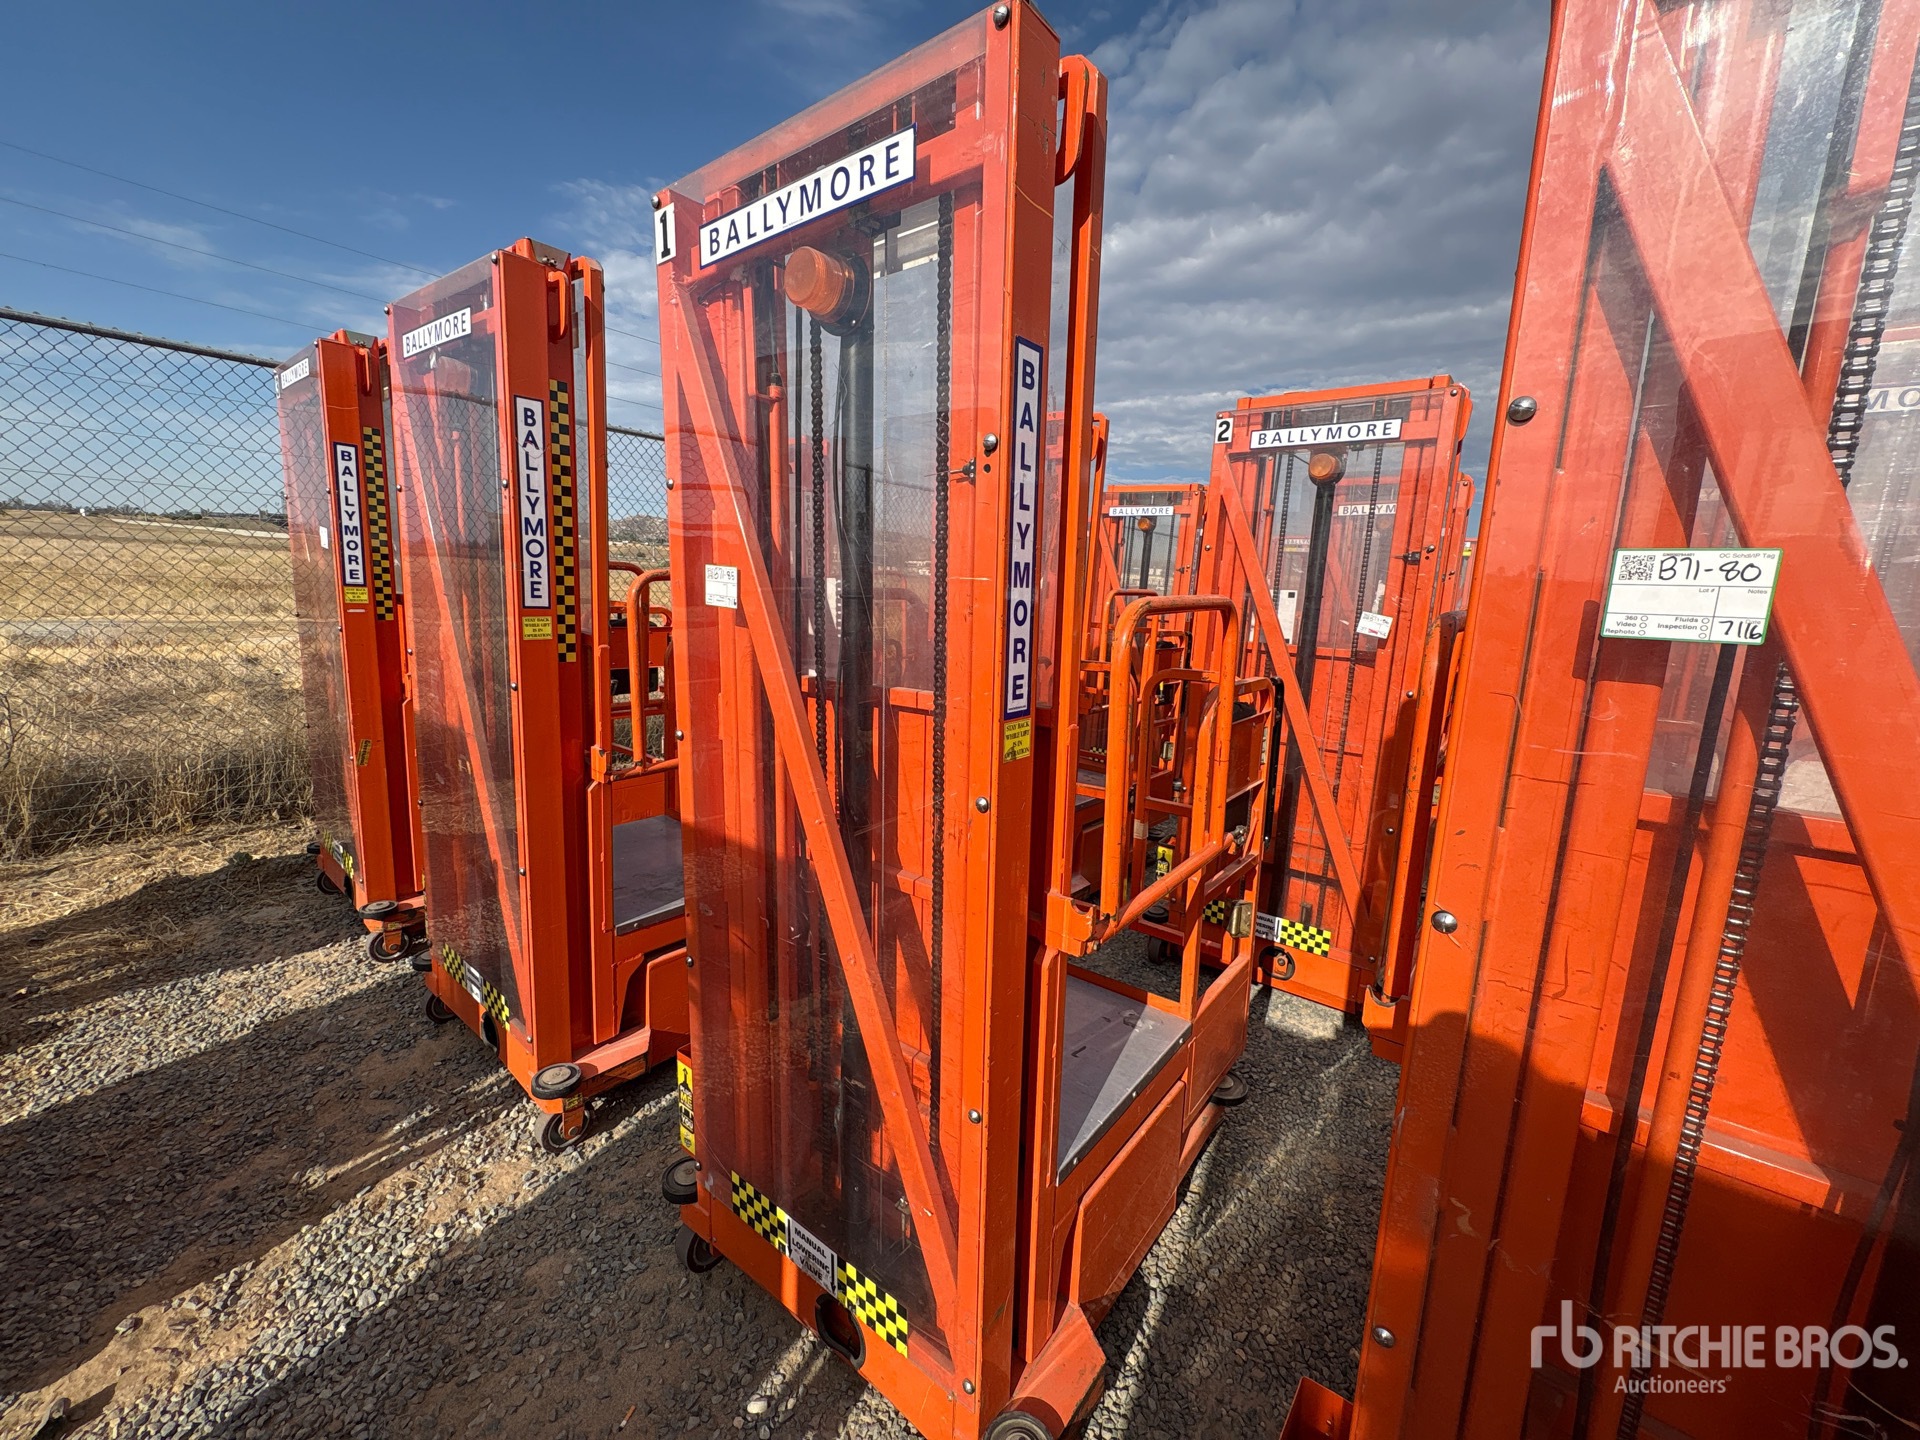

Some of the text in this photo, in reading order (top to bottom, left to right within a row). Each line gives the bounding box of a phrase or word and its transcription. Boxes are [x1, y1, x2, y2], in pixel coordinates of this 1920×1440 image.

[709, 141, 900, 257] BALLYMORE
[659, 209, 671, 259] 1
[405, 312, 467, 354] BALLYMORE
[1217, 419, 1231, 442] 2
[1257, 422, 1393, 446] BALLYMORE
[340, 449, 361, 580] BALLYMORE
[521, 407, 545, 599] BALLYMORE
[1112, 507, 1170, 515] BALLYMORE
[1343, 504, 1395, 515] BALYM
[1012, 358, 1036, 701] BALLYMORE
[1659, 555, 1762, 582] B71-80
[1657, 623, 1698, 631] Inspection
[1006, 721, 1030, 731] STAY BACK
[1006, 732, 1020, 741] WHILE
[791, 1237, 830, 1275] LOWERING
[794, 1226, 827, 1259] MANUAL
[799, 1255, 823, 1281] VALVE
